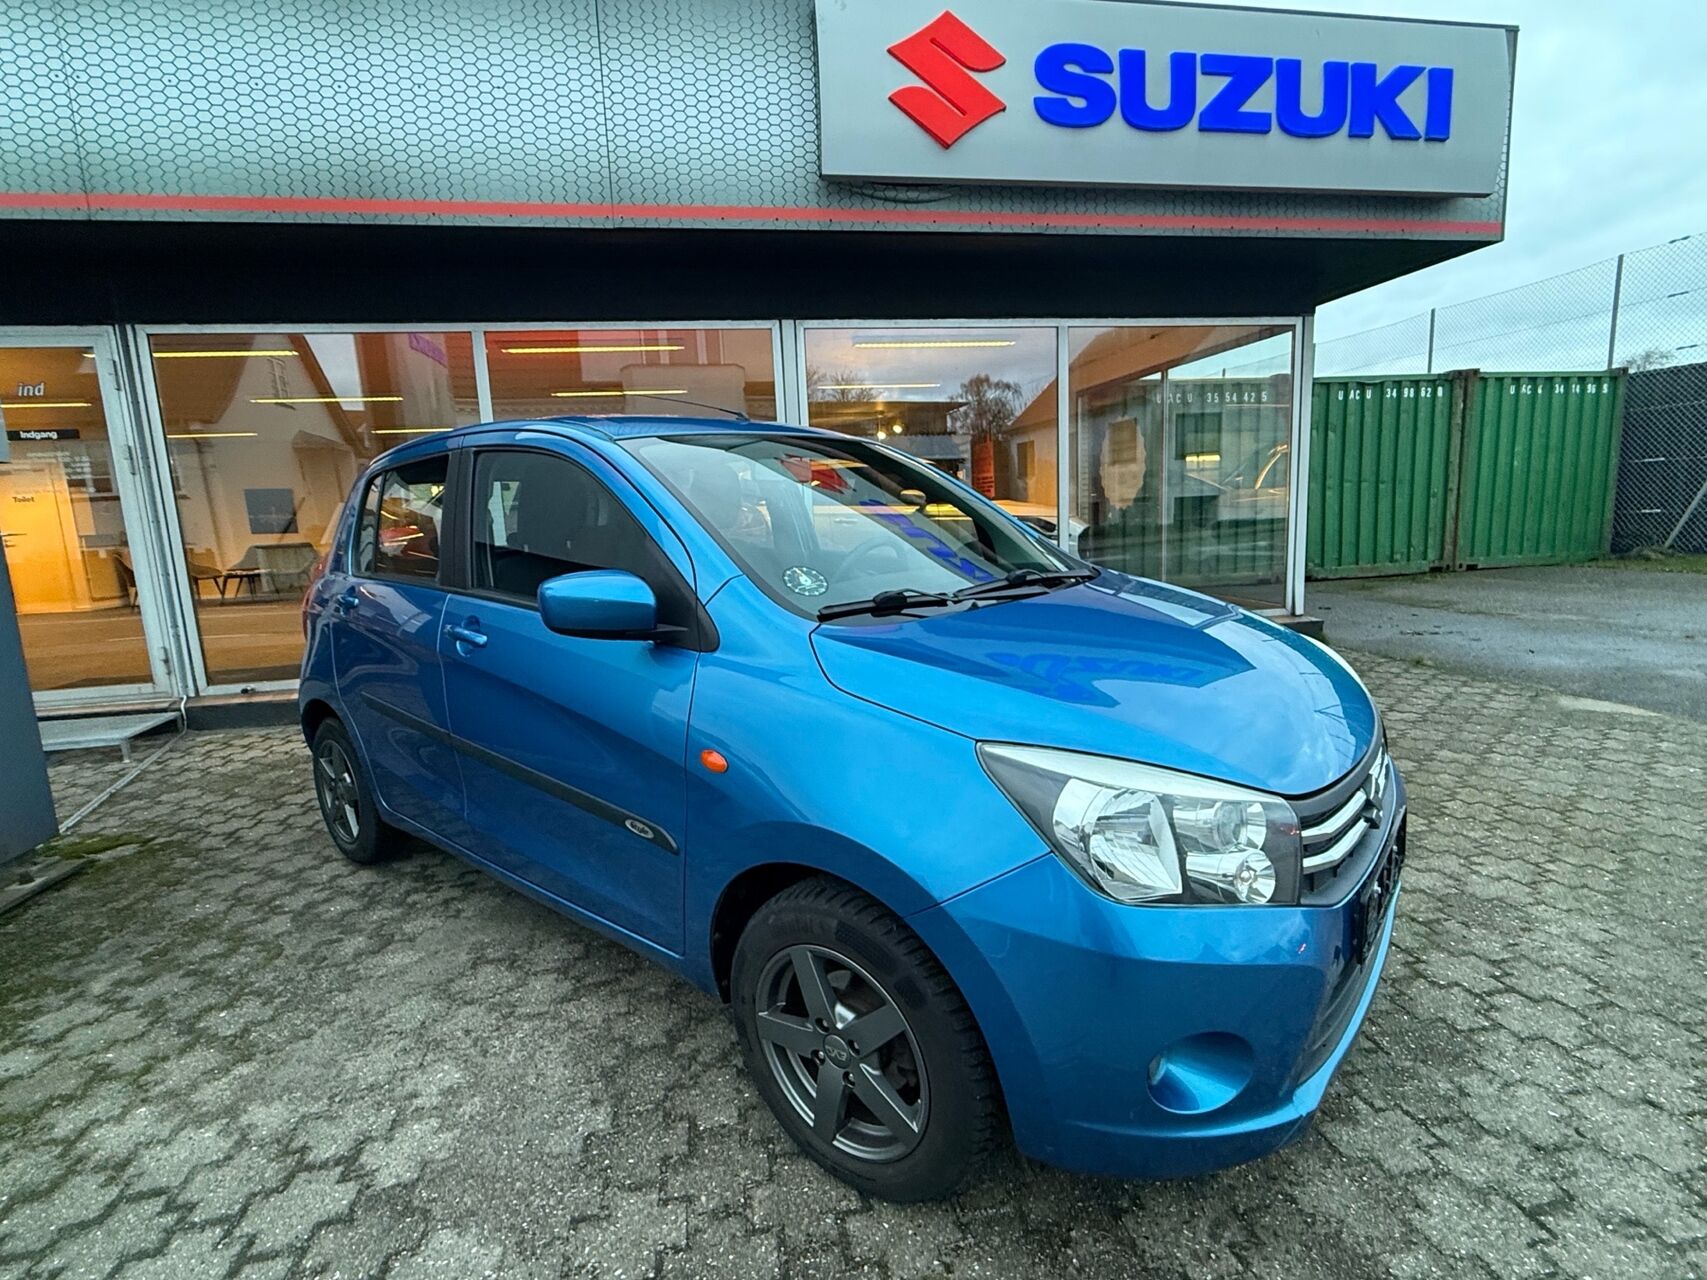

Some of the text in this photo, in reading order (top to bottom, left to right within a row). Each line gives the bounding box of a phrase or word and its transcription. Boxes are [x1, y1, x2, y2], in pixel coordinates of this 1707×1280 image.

[1033, 42, 1453, 142] SUZUKI
[18, 383, 45, 397] ind
[20, 430, 58, 440] Indgang
